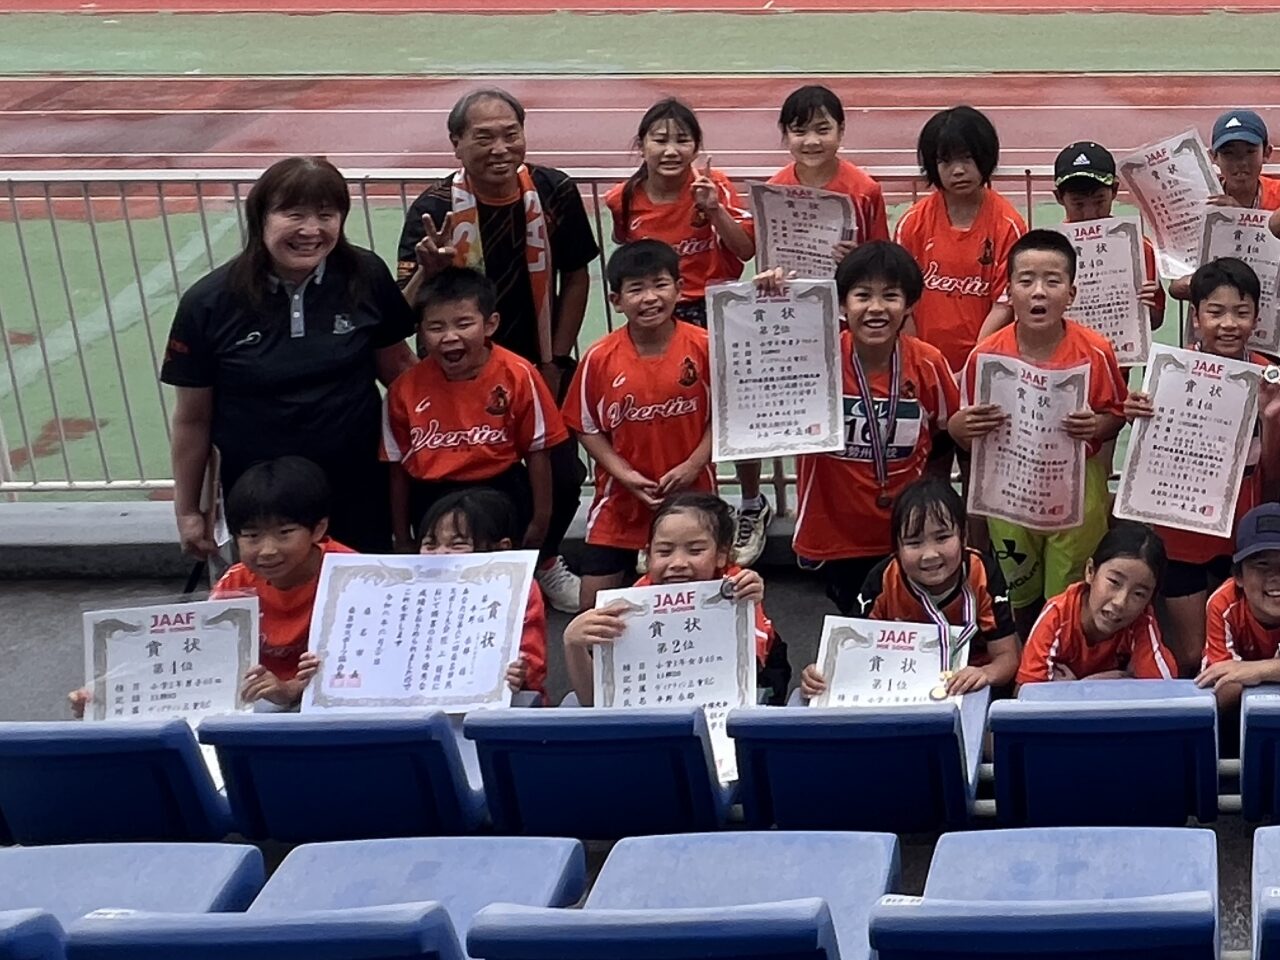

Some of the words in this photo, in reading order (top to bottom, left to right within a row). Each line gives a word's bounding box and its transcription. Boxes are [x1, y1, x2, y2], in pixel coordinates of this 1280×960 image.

[1240, 213, 1266, 223] JAAF
[1074, 225, 1102, 237] JAAF
[1193, 359, 1225, 374] JAAF
[1020, 368, 1048, 386] JAAF
[653, 590, 697, 608] JAAF
[151, 611, 196, 628] JAAF
[480, 600, 502, 649] 賞状
[648, 617, 702, 639] 賞状
[877, 629, 918, 644] JAAF
[145, 637, 202, 658] 賞状
[656, 640, 695, 654] 第2位
[868, 655, 918, 674] 賞状
